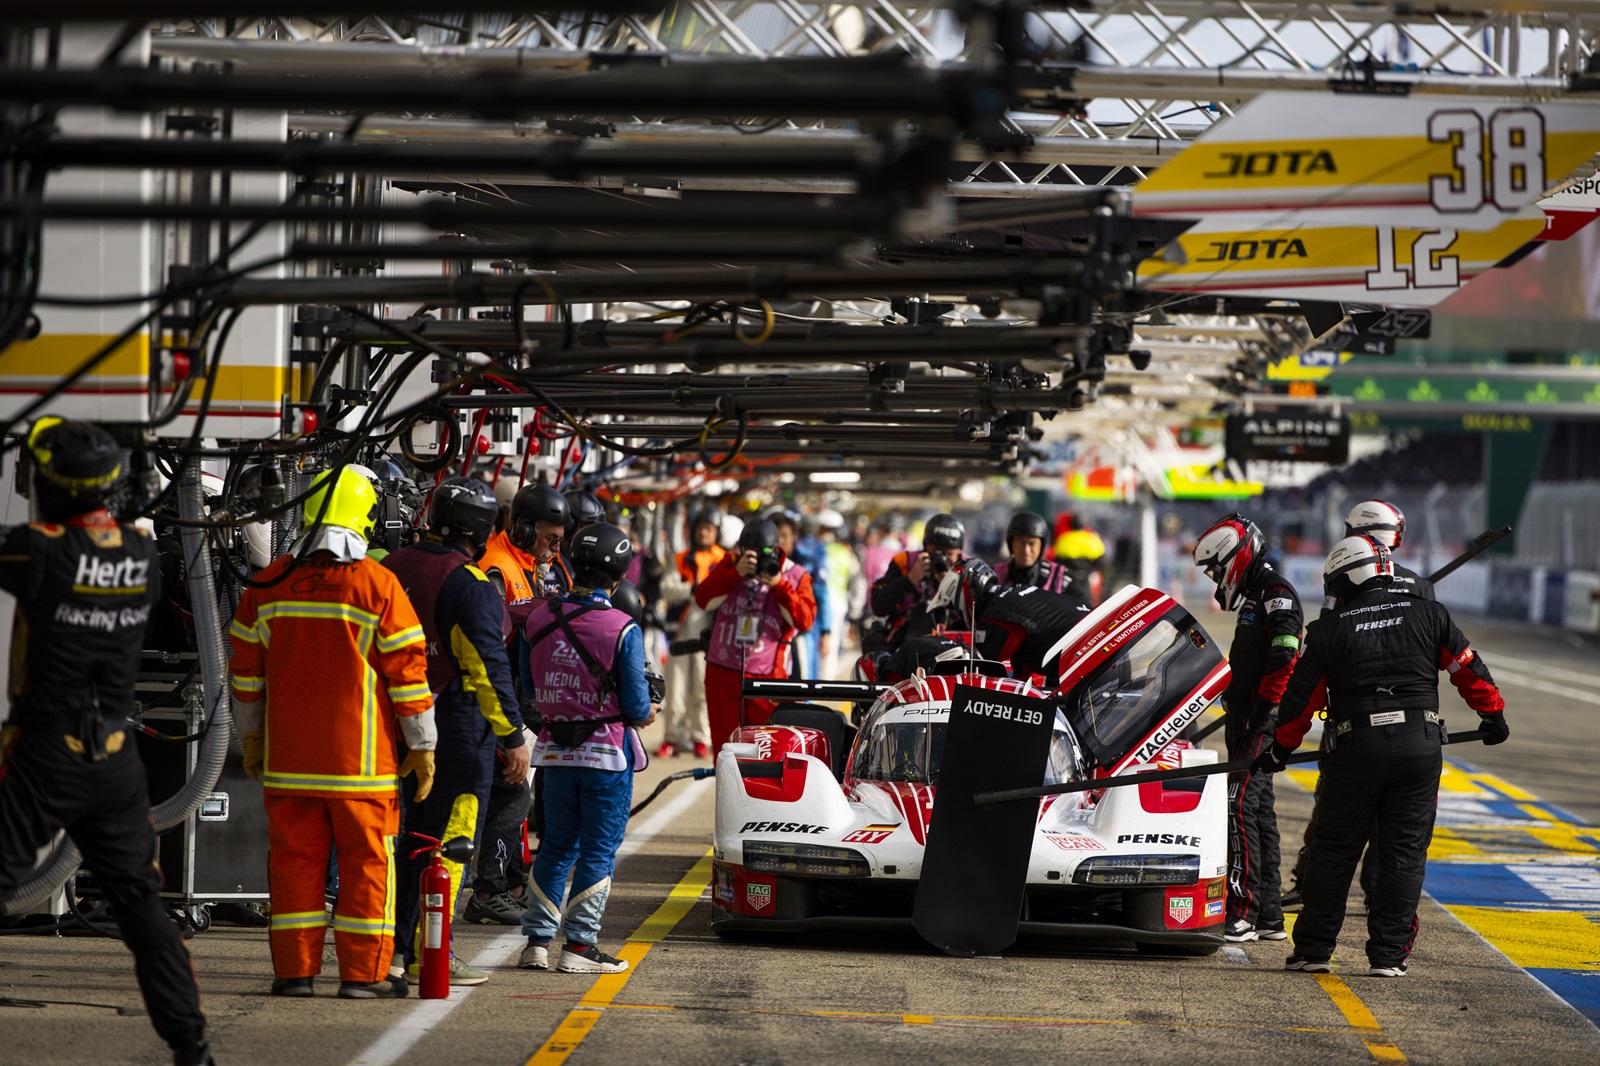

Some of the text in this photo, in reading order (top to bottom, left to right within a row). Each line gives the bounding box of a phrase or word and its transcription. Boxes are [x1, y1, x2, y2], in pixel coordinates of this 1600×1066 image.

[1203, 149, 1338, 178] JOTA
[1428, 107, 1546, 214] 38
[1196, 238, 1308, 262] JOTA
[1365, 226, 1461, 291] 12
[1243, 419, 1342, 435] ALPINE
[74, 554, 150, 588] Hertz
[311, 560, 358, 573] SAFETY
[1120, 599, 1149, 620] LOTTERER
[1340, 601, 1411, 619] PORSCHE
[1115, 619, 1146, 643] VANTHOOR
[1355, 616, 1403, 632] PENSKE
[1088, 631, 1106, 647] ESTRE
[544, 671, 581, 689] MEDIA
[963, 700, 1043, 725] GET READY
[738, 821, 830, 835] PENSKE
[848, 830, 887, 843] HY
[1117, 833, 1202, 848] PENSKE
[1058, 841, 1101, 849] CAR
[749, 885, 769, 895] TAG
[748, 895, 769, 908] HEUER
[1172, 899, 1192, 908] TAG
[1170, 908, 1192, 921] HEUER
